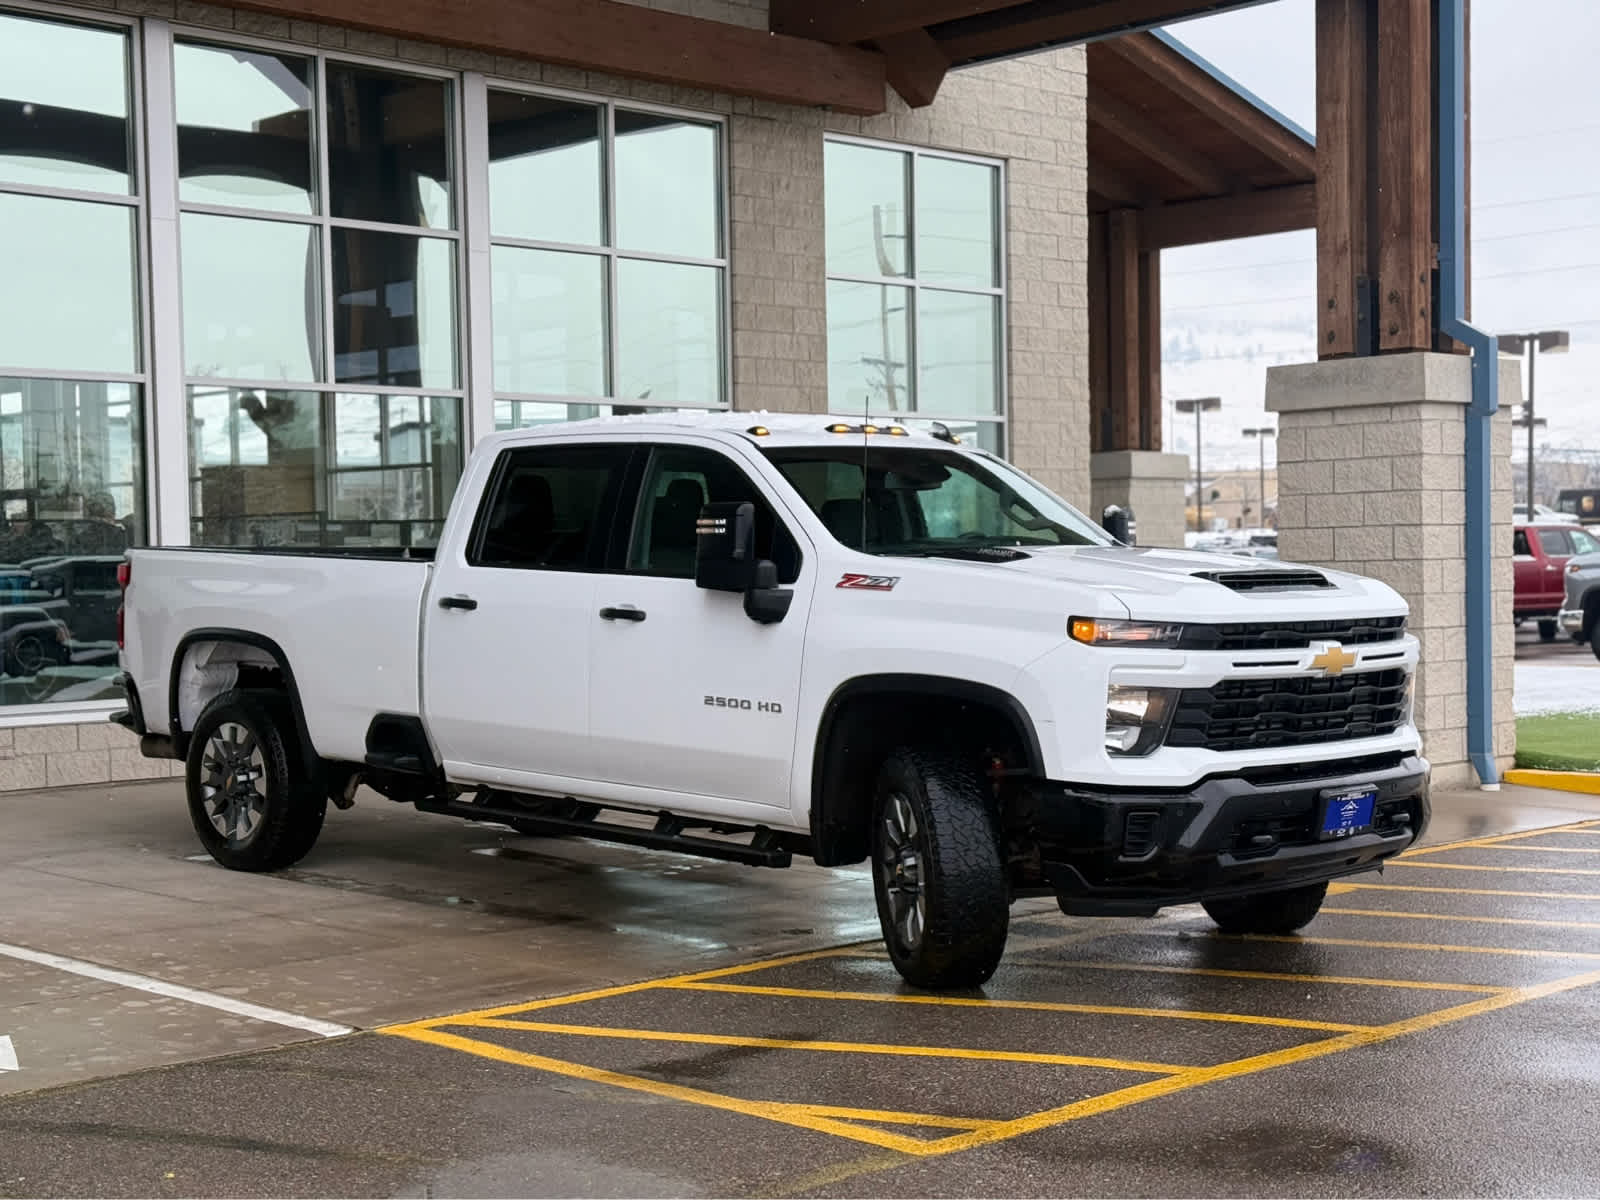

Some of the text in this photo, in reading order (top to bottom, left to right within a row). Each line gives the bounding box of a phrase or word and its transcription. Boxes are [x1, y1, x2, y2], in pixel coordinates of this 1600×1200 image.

[836, 573, 901, 591] Z71
[704, 695, 782, 713] 2500 HD
